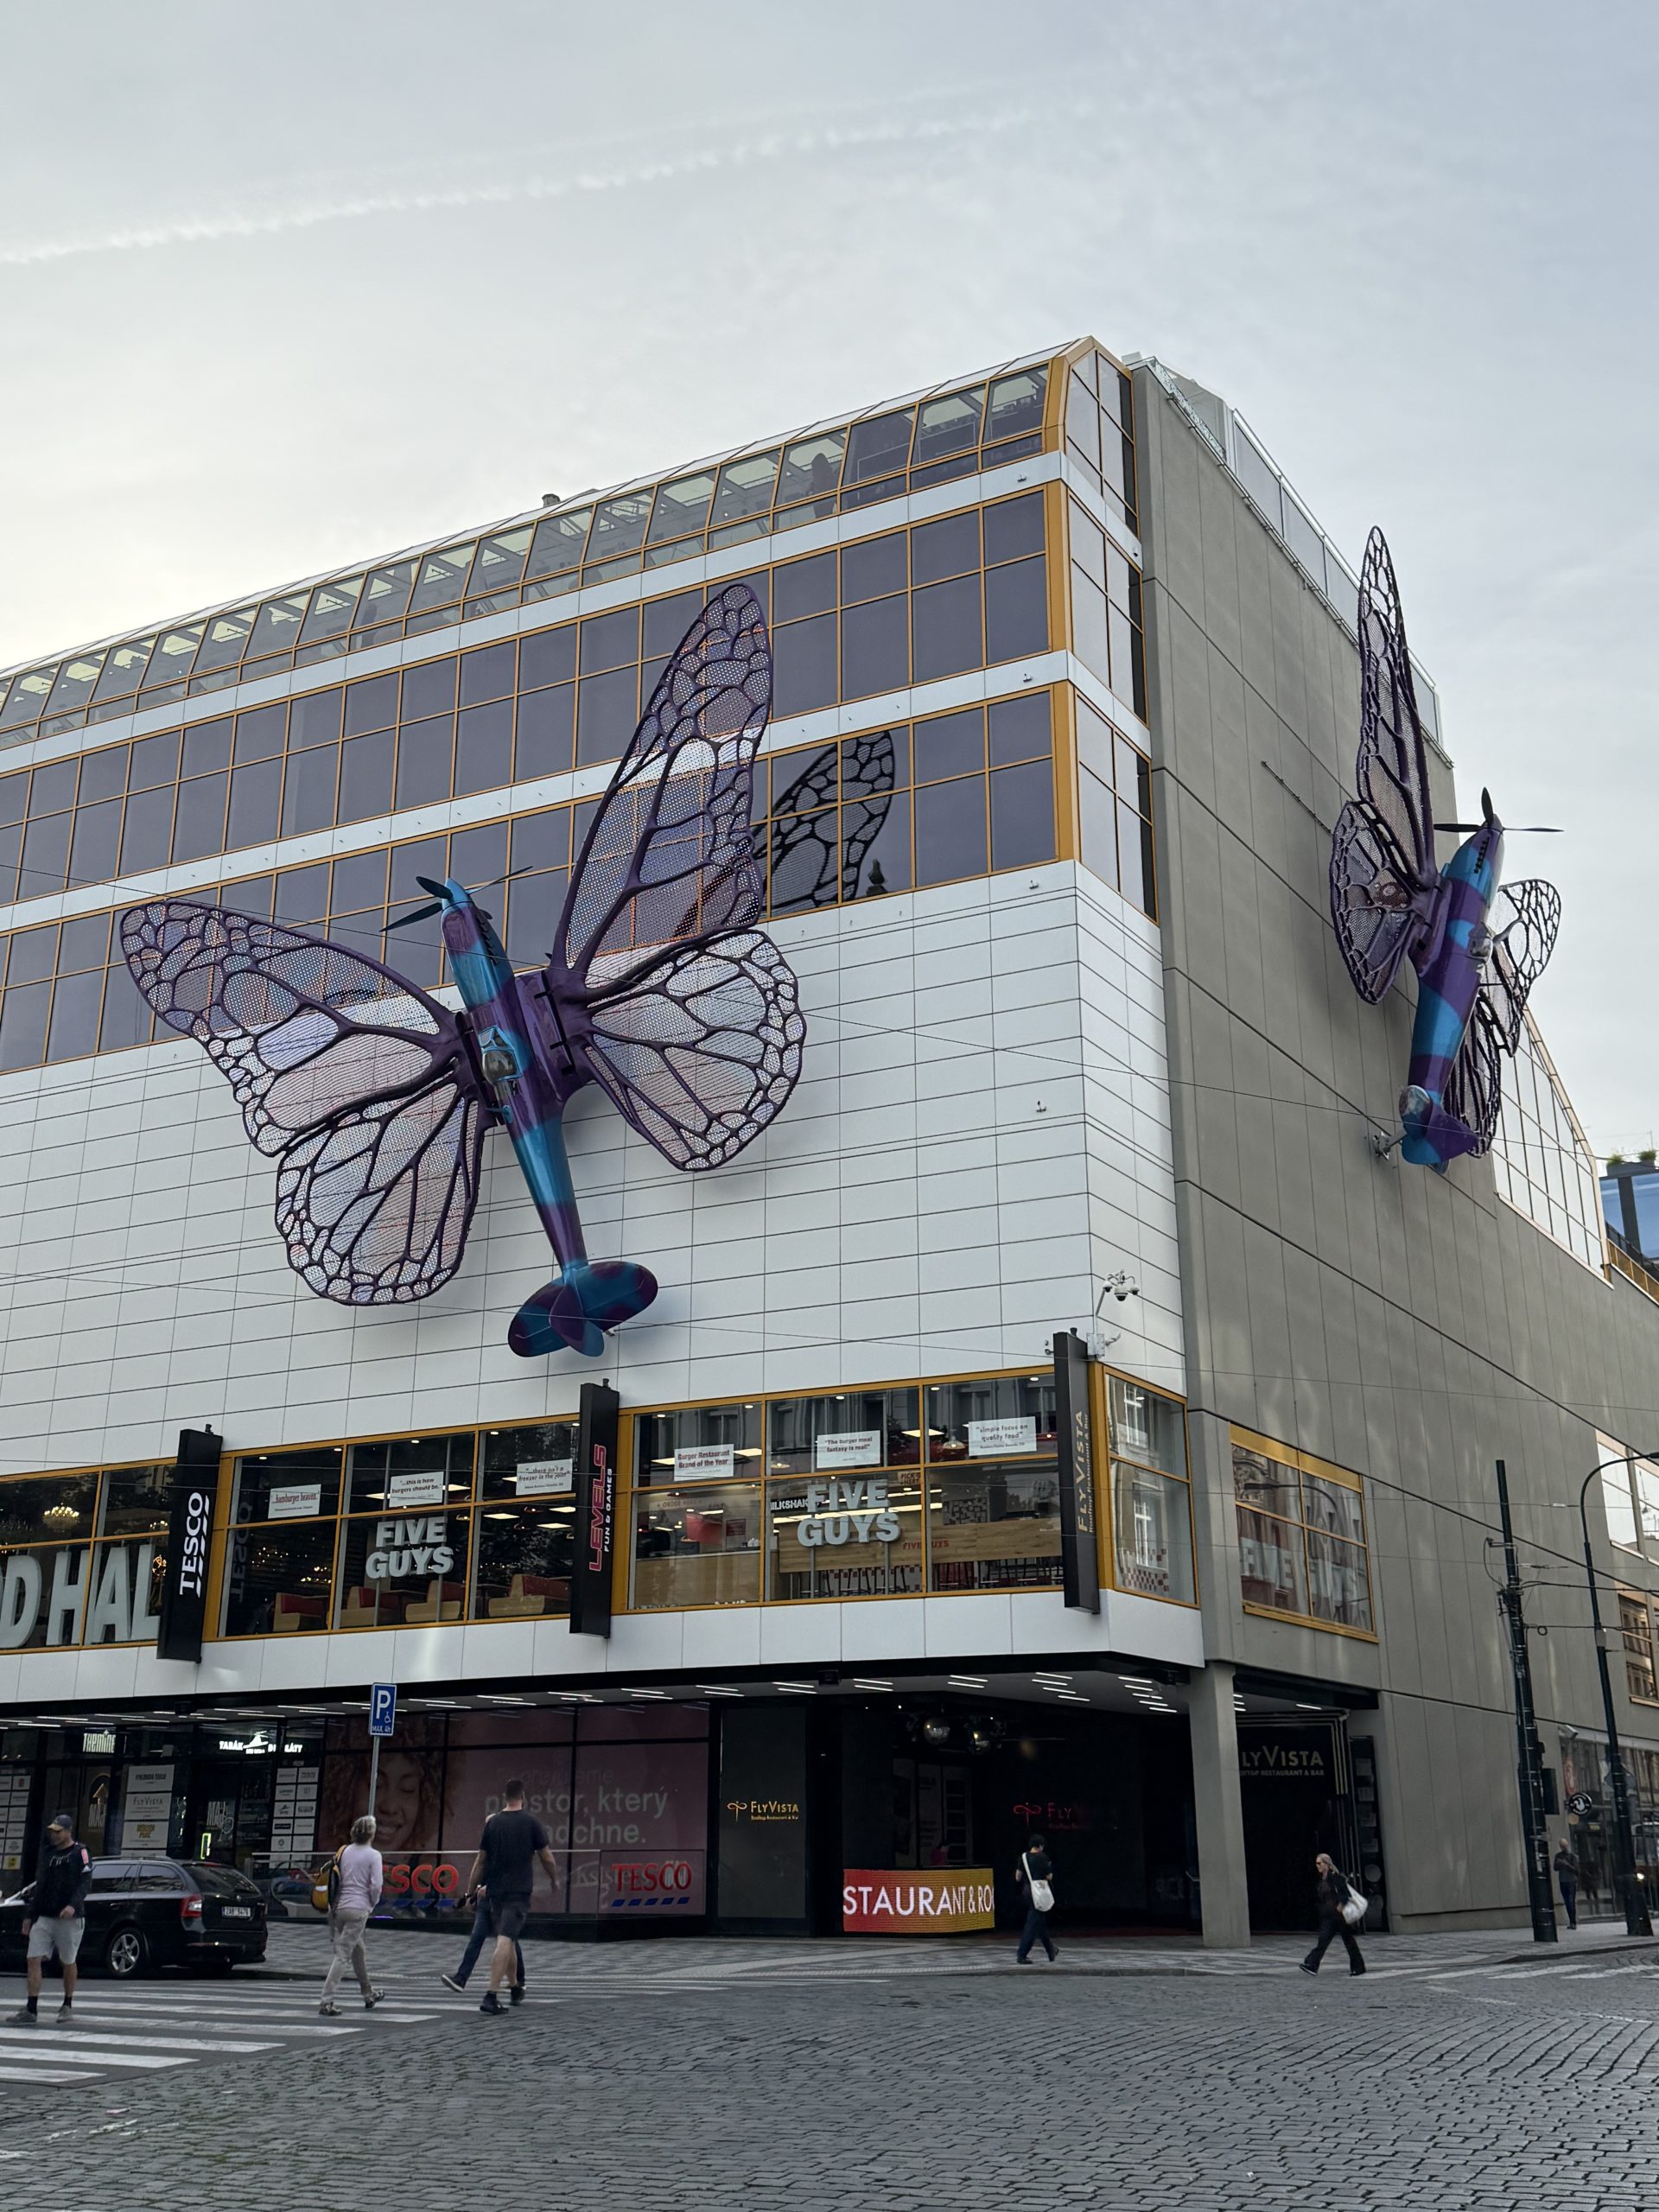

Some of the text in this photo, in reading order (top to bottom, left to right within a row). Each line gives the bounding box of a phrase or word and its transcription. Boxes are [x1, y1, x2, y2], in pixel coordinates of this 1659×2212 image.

[678, 1460, 696, 1469] Brand
[696, 1459, 702, 1468] of
[715, 1458, 728, 1466] Year
[698, 1449, 730, 1459] Restaurant
[588, 1444, 607, 1572] LEVELS
[770, 1497, 820, 1511] ILKSHAK
[807, 1478, 892, 1512] FIVE
[179, 1491, 204, 1596] TESCO
[375, 1516, 448, 1548] FIVE
[797, 1512, 901, 1548] GUYS
[931, 1539, 950, 1549] UYS
[365, 1546, 454, 1580] GUYS
[0, 1555, 42, 1649] D
[376, 1689, 391, 1719] P
[1242, 1745, 1324, 1767] LYVISTA
[485, 1787, 588, 1816] pstor,
[545, 1816, 646, 1844] adchne.
[382, 1863, 460, 1894] SCO
[610, 1861, 692, 1893] TESCO
[842, 1885, 967, 1916] STAURANT
[968, 1885, 976, 1914] &
